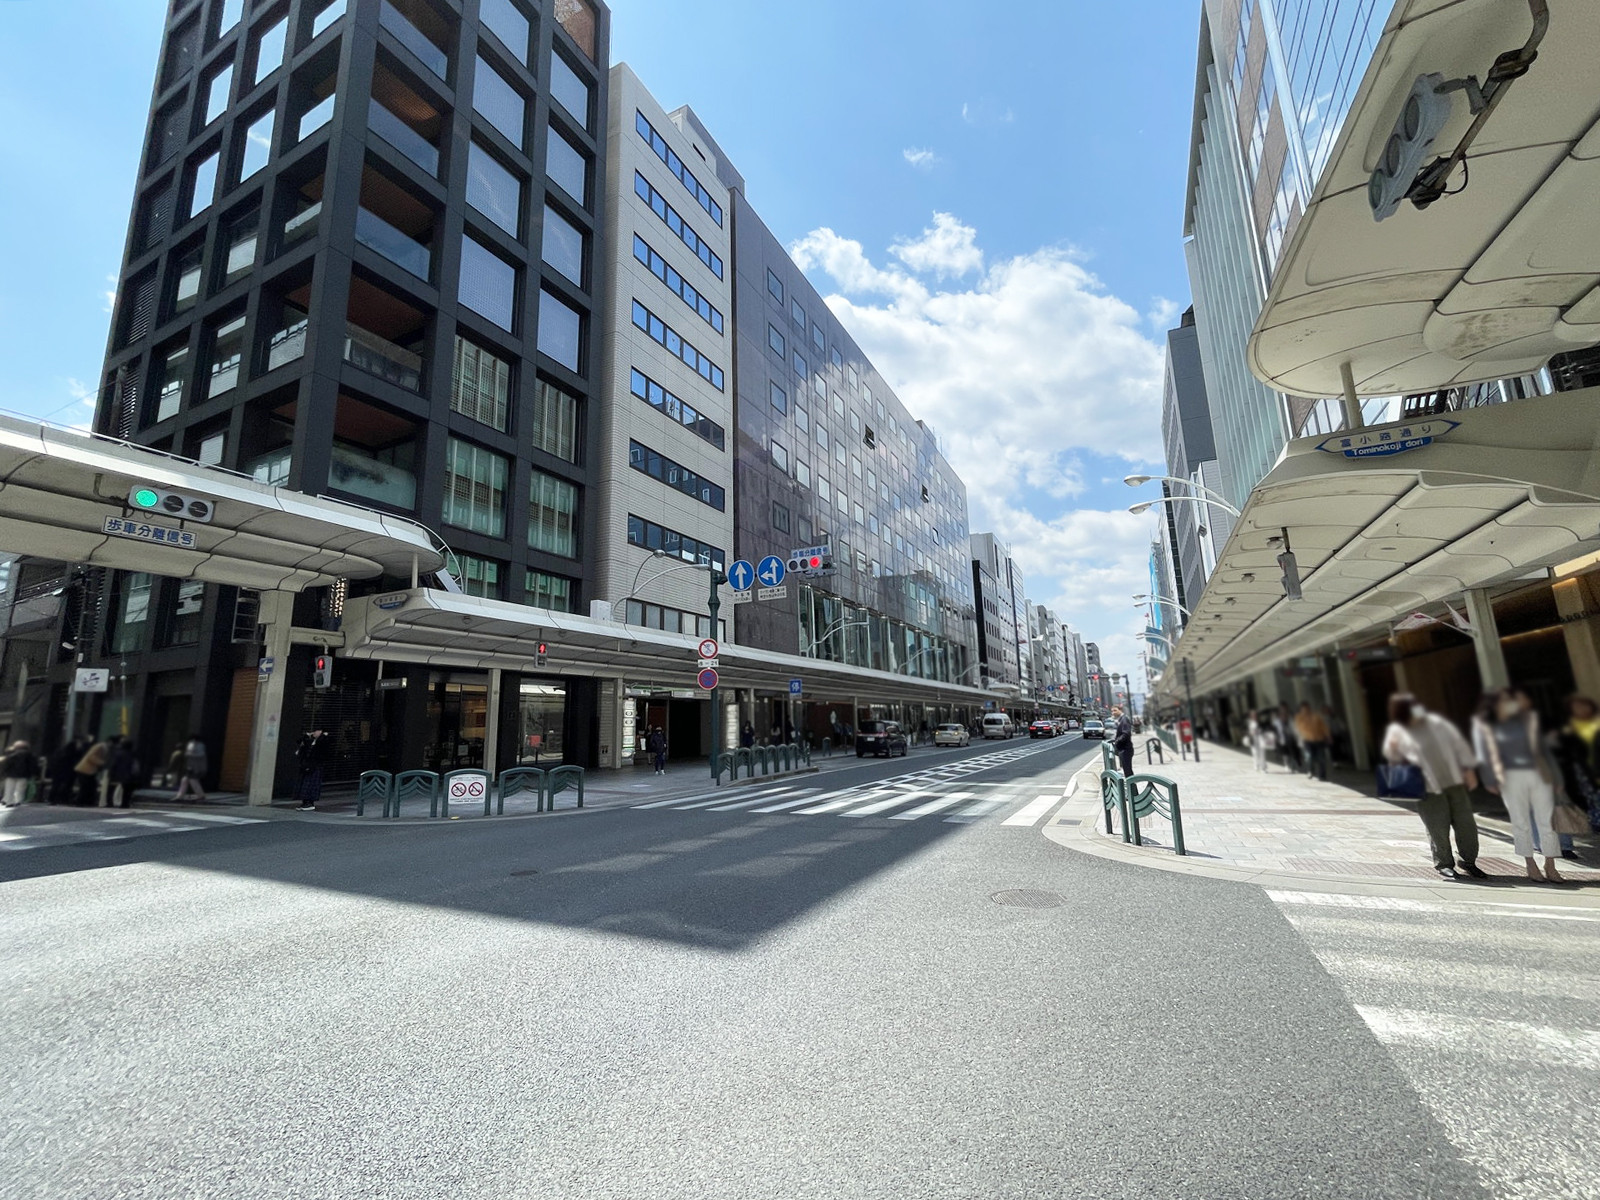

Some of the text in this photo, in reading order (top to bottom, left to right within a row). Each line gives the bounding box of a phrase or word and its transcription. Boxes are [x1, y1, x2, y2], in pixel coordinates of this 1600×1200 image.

[1351, 438, 1424, 456] Tominokoji dori
[107, 518, 193, 545] 歩車分離信号
